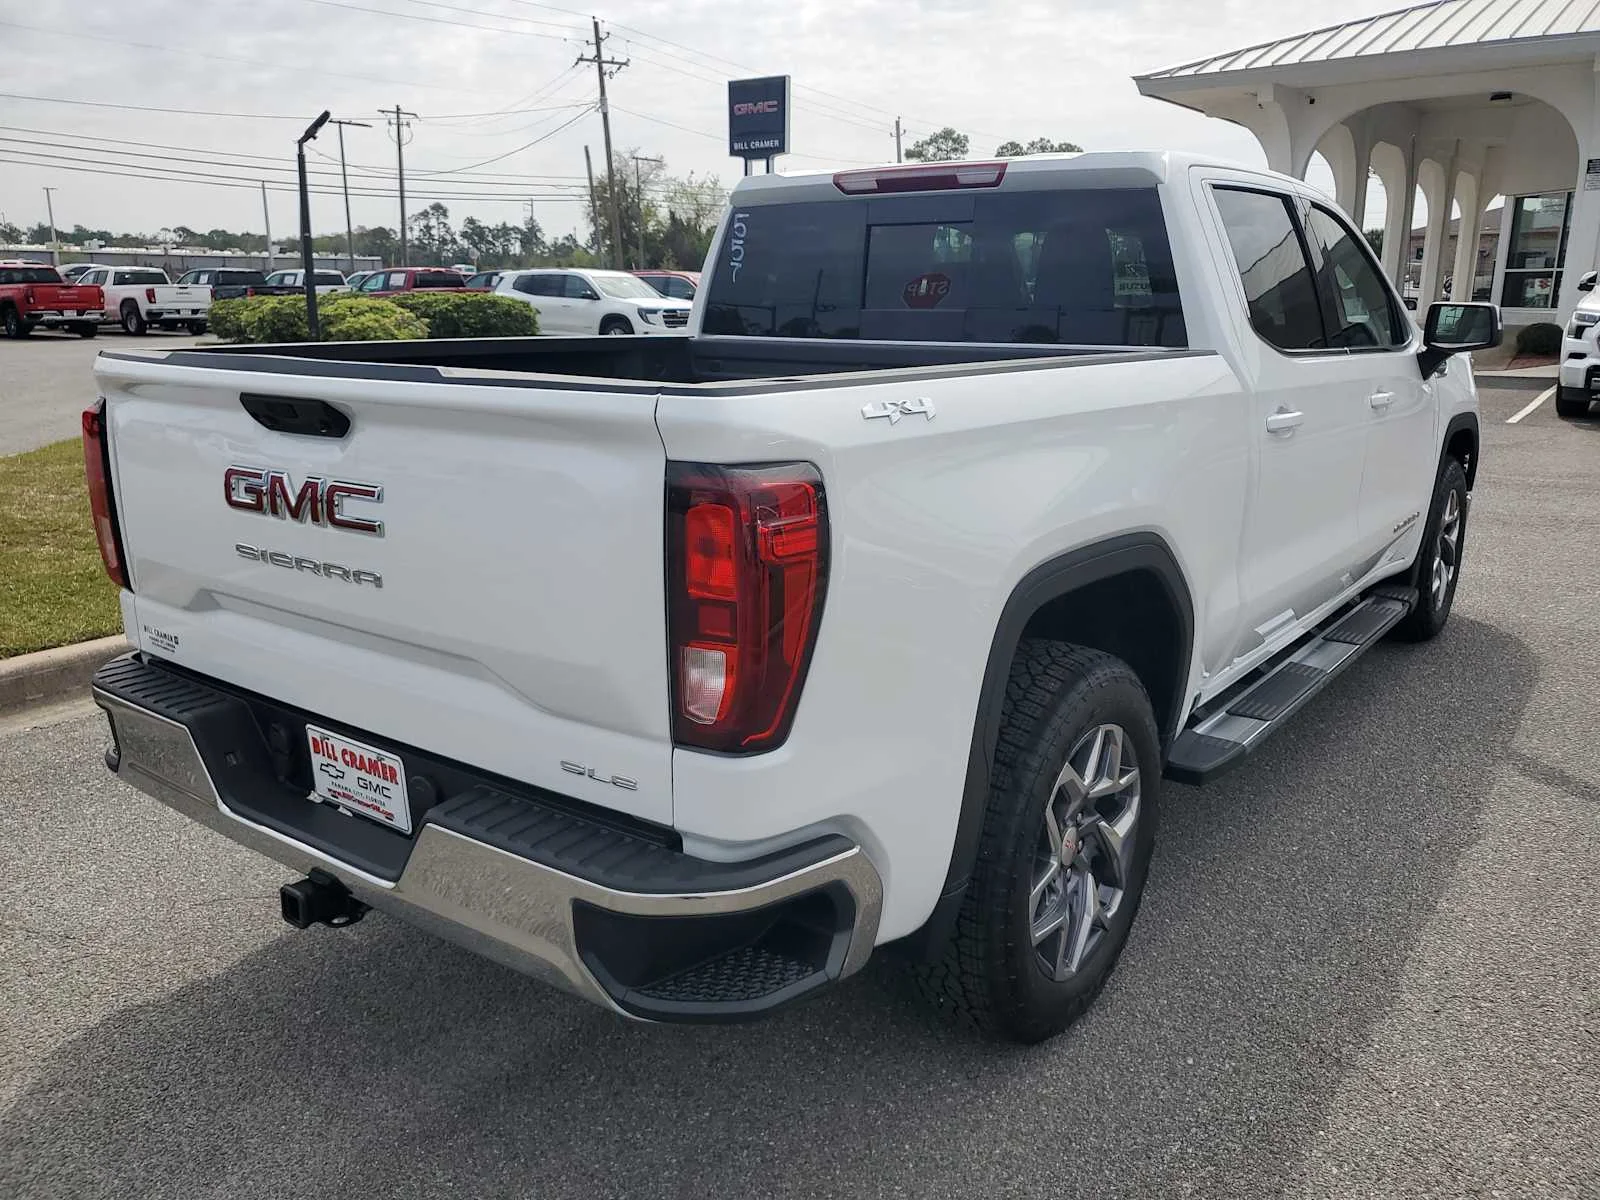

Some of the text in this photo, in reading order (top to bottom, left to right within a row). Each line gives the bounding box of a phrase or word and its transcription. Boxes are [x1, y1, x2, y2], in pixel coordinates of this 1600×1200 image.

[733, 100, 778, 116] GMC
[733, 139, 780, 151] BILL CRAMER
[224, 464, 385, 538] GMC
[235, 542, 384, 588] SIERRA
[311, 736, 399, 785] BILL CRAMER
[560, 760, 638, 791] SLE
[357, 776, 392, 799] GMC
